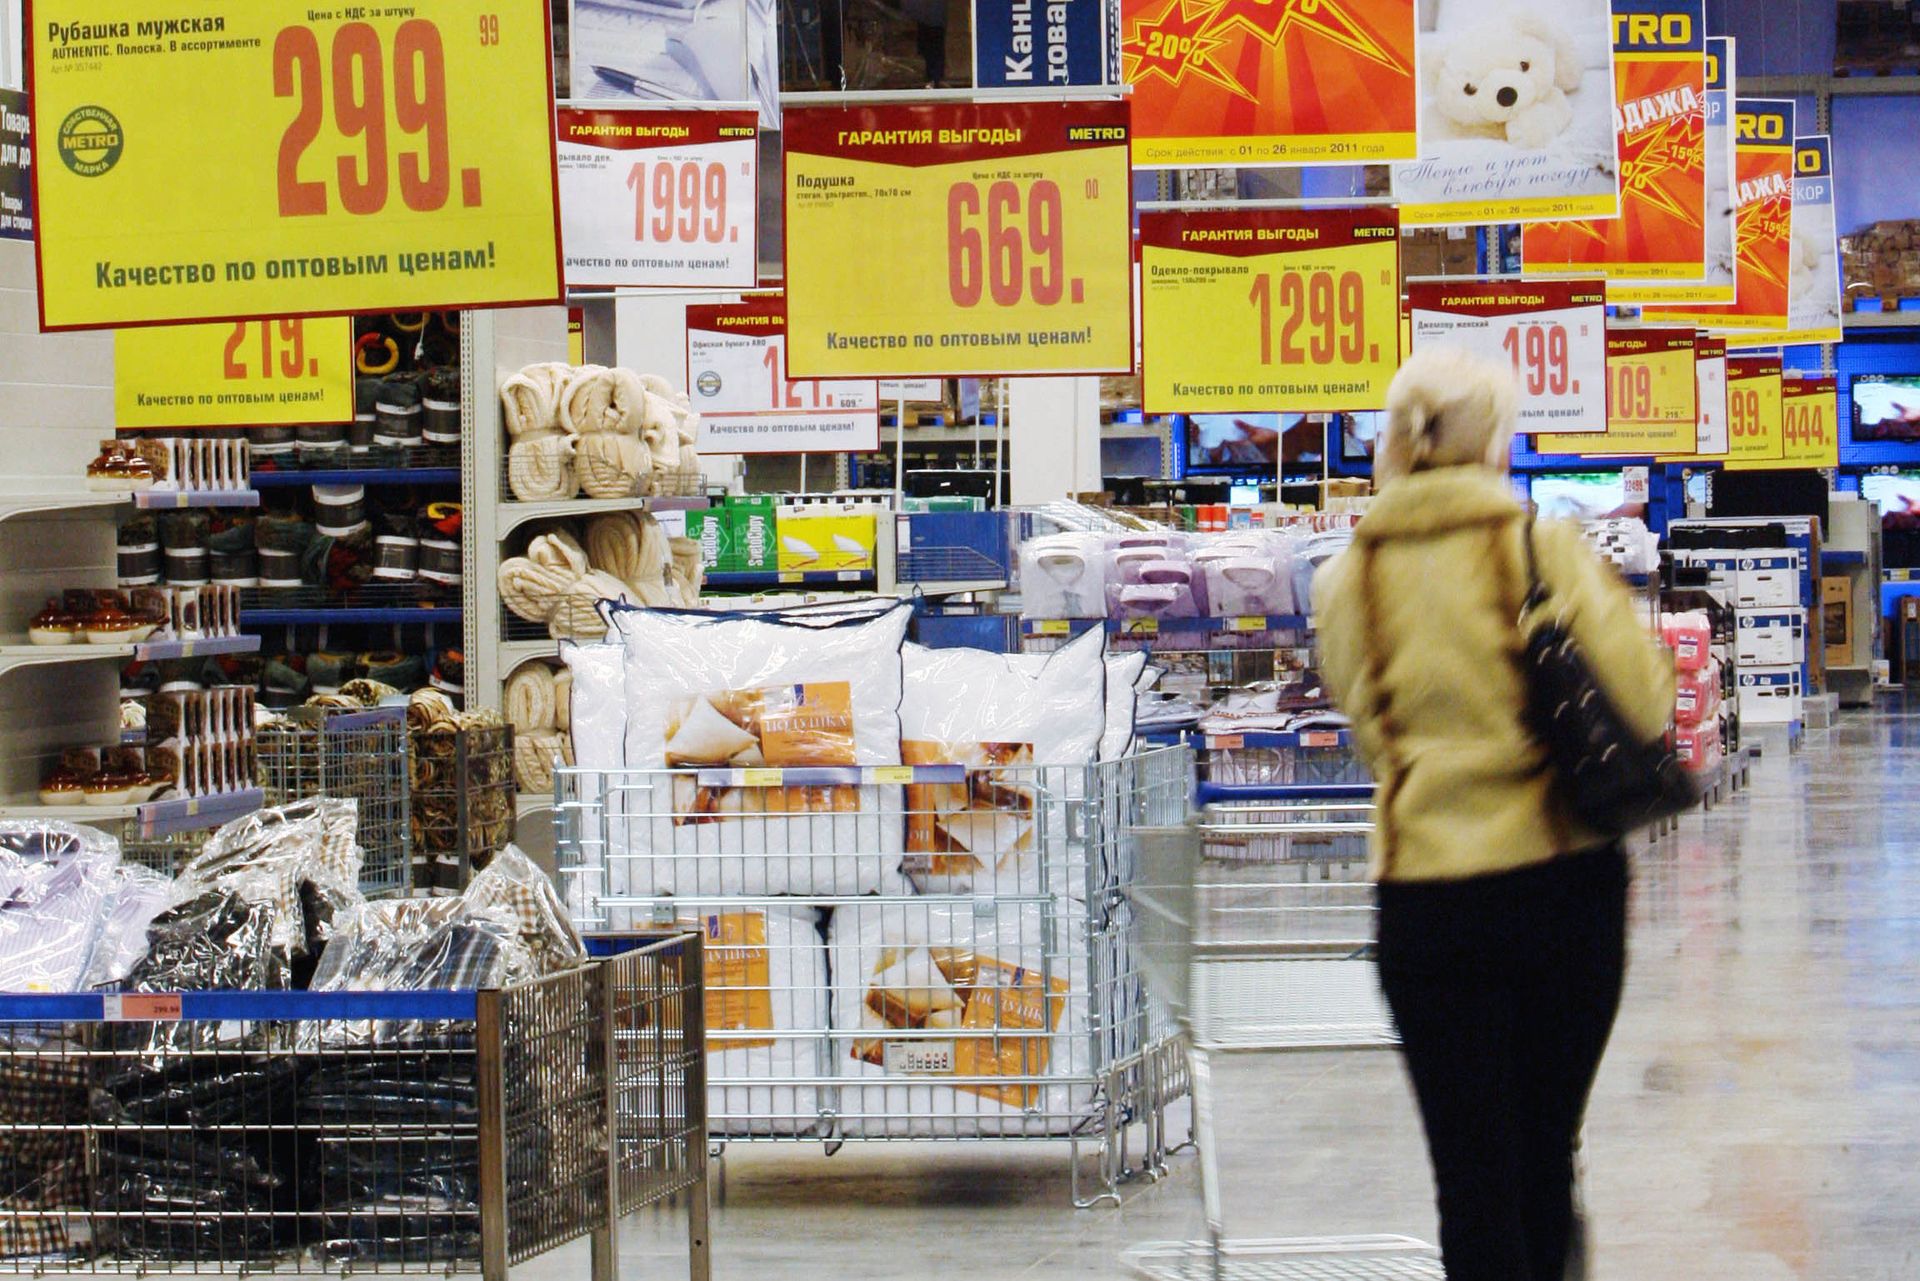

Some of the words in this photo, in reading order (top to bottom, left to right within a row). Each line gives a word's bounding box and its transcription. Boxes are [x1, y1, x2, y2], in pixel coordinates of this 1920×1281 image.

[308, 9, 332, 21] Цена
[345, 7, 365, 19] НДС
[384, 7, 415, 18] штуку
[49, 22, 129, 45] Рубашка
[137, 16, 225, 39] мужская
[52, 45, 113, 59] AUTHENTIC.
[117, 42, 165, 55] Полоска.
[170, 40, 176, 51] В
[181, 38, 261, 52] ассортименте
[1047, 0, 1073, 82] това
[62, 107, 119, 135] СОБСТВЕННАЯ
[570, 125, 632, 136] ГАРАНТИЯ
[636, 126, 689, 137] ВЫГОДЫ
[719, 128, 755, 136] METRO
[838, 129, 932, 145] ГАРАНТИЯ
[939, 128, 1021, 144] ВЫГОДЫ
[1069, 127, 1125, 140] METRO
[63, 134, 119, 149] METRO
[1, 144, 17, 166] для
[1146, 147, 1172, 158] Срок
[1239, 145, 1252, 155] 01
[1272, 144, 1286, 155] 26
[1290, 145, 1326, 156] января
[1330, 143, 1358, 154] 2011
[1361, 144, 1384, 155] года
[73, 160, 109, 175] МАРКА
[1400, 153, 1473, 183] Тепло
[797, 173, 855, 189] Подушка
[1794, 185, 1824, 200] КОР
[626, 161, 738, 243] 1999.
[1552, 203, 1573, 212] 2011
[1182, 230, 1252, 241] ГАРАНТИЯ
[1257, 228, 1318, 240] ВЫГОДЫ
[1354, 227, 1395, 238] METRO
[947, 179, 1084, 308] 669.
[96, 261, 215, 289] Качество
[227, 261, 255, 281] по
[266, 253, 387, 280] оптовым
[399, 242, 496, 276] ценам!
[615, 257, 627, 268] по
[631, 257, 684, 268] оптовым
[688, 257, 729, 270] ценам!
[1441, 296, 1495, 306] ГАРАНТИЯ
[1498, 295, 1544, 305] ВЫГОДЫ
[1571, 295, 1602, 303] METRO
[716, 316, 769, 326] ГАРАНТИЯ
[1248, 271, 1379, 365] 1299.
[827, 332, 906, 350] Качество
[914, 334, 933, 348] по
[940, 332, 1021, 347] оптовым
[1028, 326, 1092, 346] ценам!
[1173, 382, 1234, 395] Качество
[1238, 384, 1254, 395] по
[1258, 383, 1318, 394] оптовым
[1323, 380, 1370, 395] ценам!
[137, 393, 194, 407] Качество
[198, 394, 212, 405] по
[217, 393, 275, 406] оптовым
[279, 388, 324, 404] ценам!
[1548, 406, 1584, 419] ценам!
[710, 423, 754, 434] Качество
[757, 424, 768, 433] по
[772, 423, 817, 433] оптовым
[819, 421, 855, 432] ценам!
[701, 516, 719, 568] SvetoCopy
[747, 515, 765, 567] SvetoCopy
